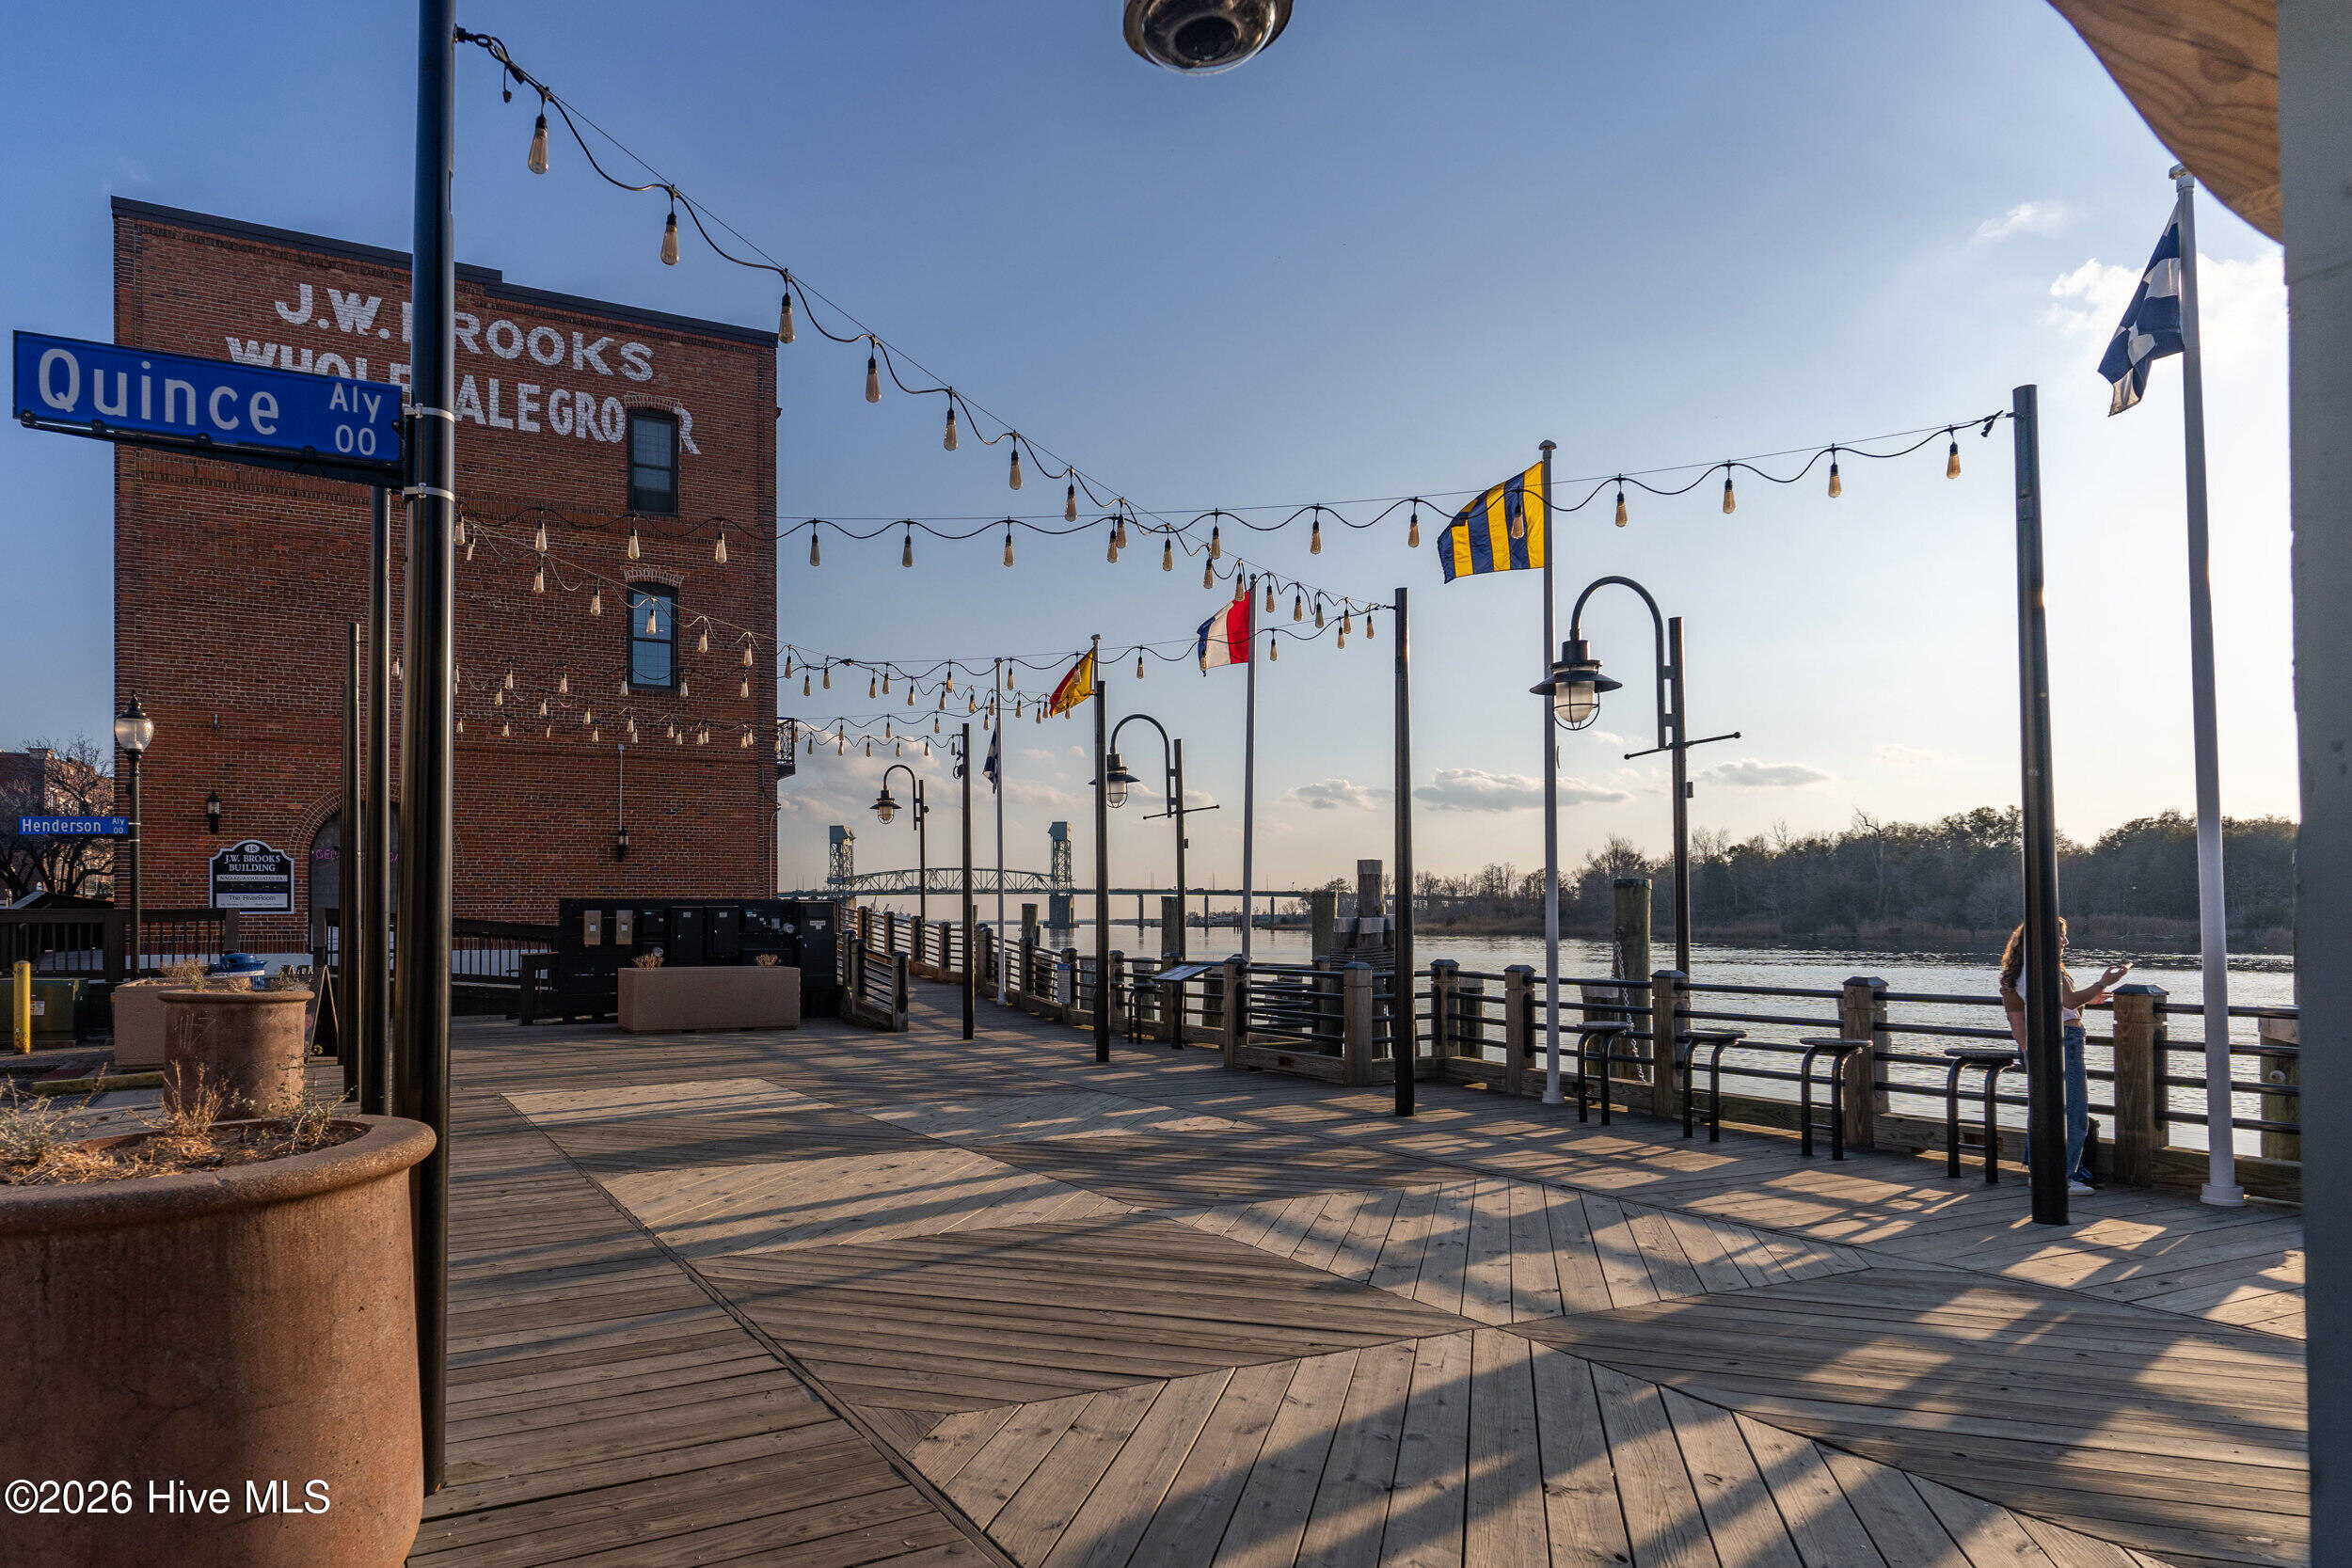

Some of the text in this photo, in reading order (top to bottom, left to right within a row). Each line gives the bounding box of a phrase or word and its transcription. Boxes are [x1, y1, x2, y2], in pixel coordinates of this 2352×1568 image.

[275, 283, 390, 340] J.W.
[39, 347, 279, 436] Quince
[329, 382, 382, 423] Aly
[335, 424, 376, 455] 00
[22, 818, 102, 832] Henderson
[112, 817, 125, 826] Aly
[224, 854, 281, 863] J.W. BROOKS
[229, 863, 276, 872] BUILDING
